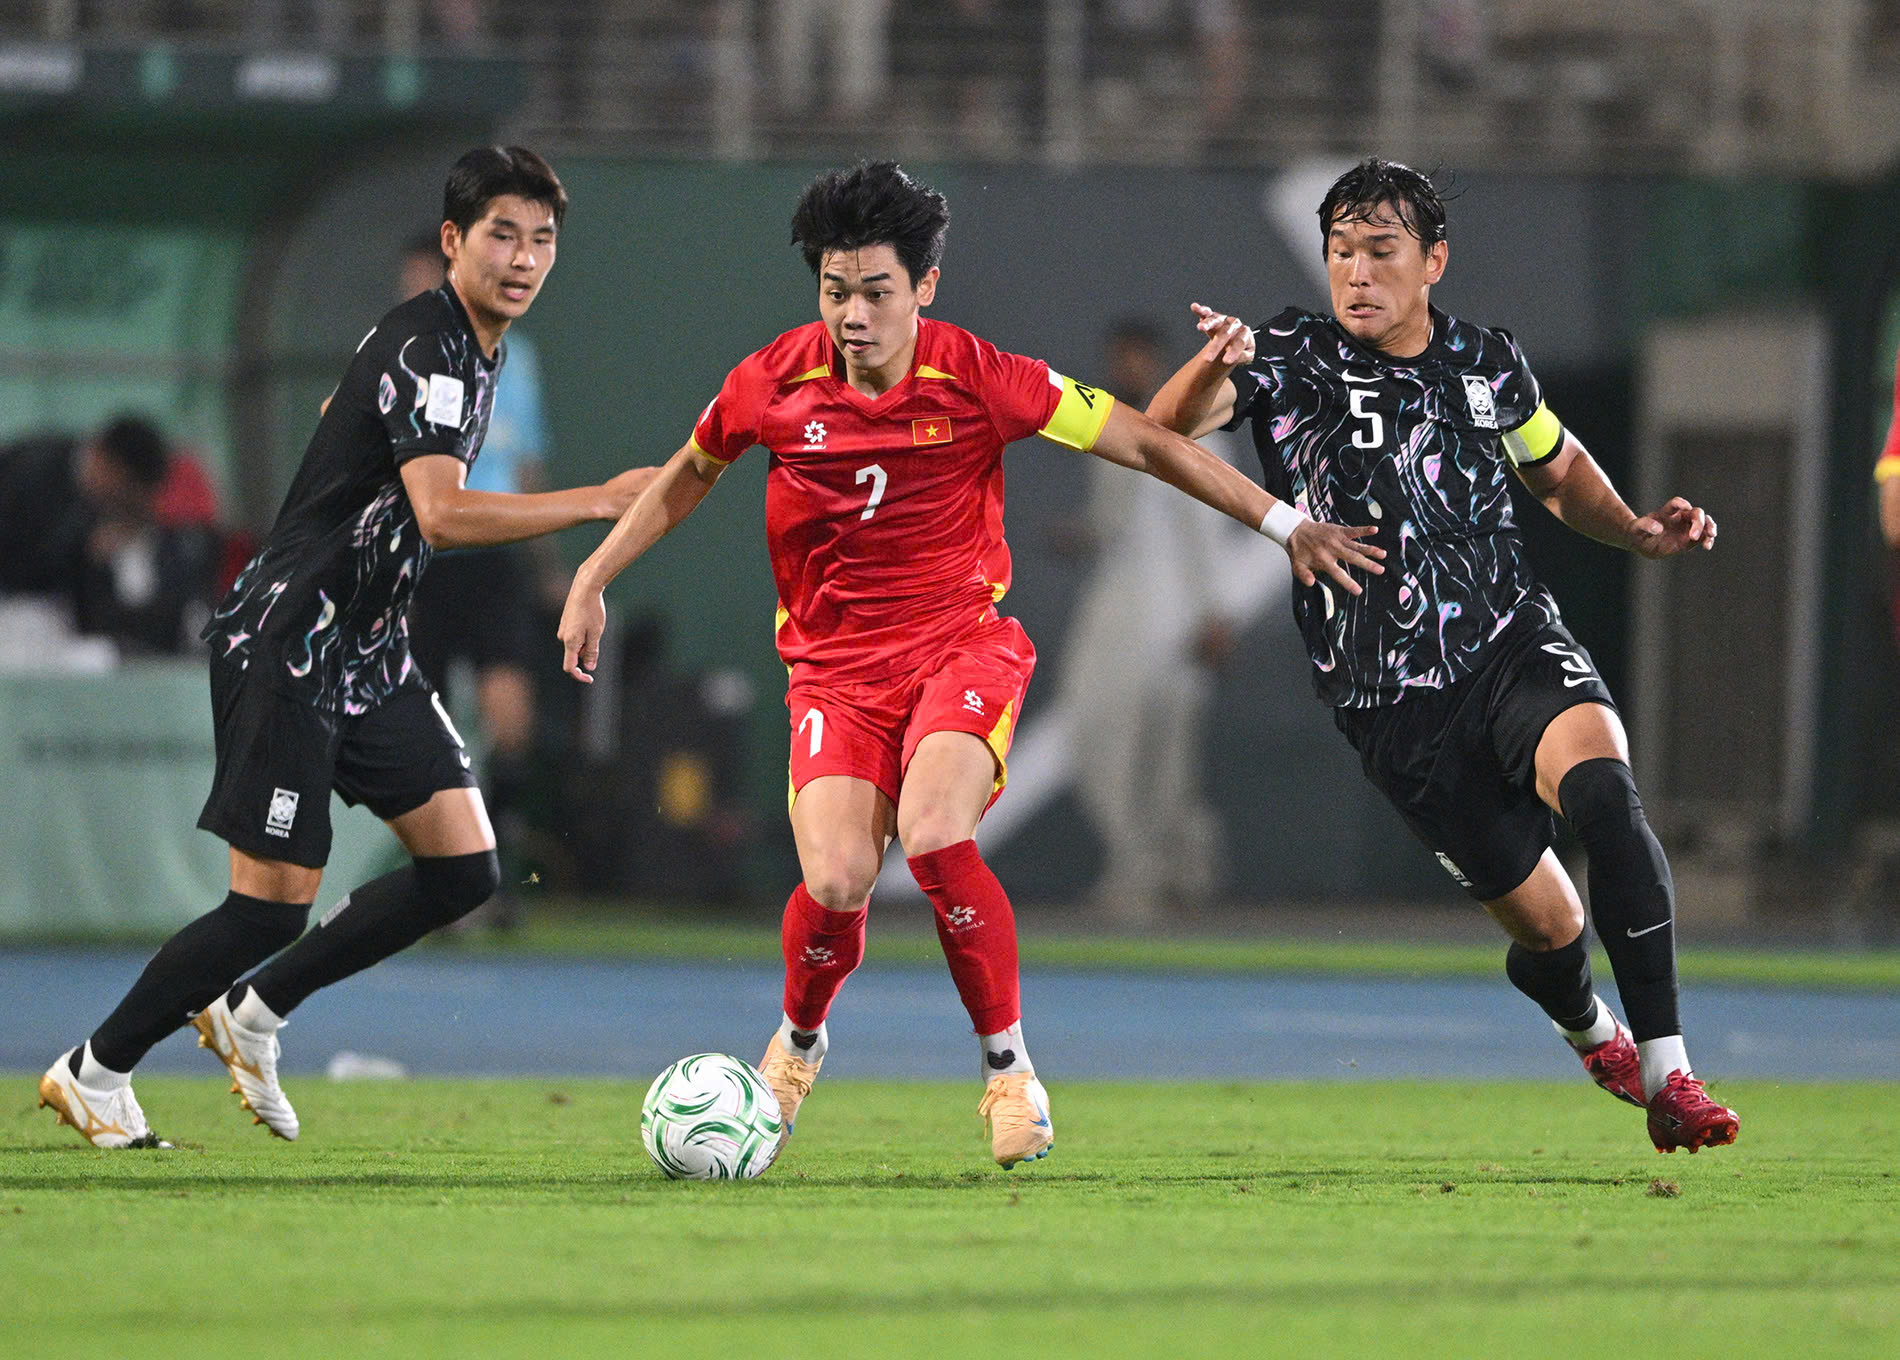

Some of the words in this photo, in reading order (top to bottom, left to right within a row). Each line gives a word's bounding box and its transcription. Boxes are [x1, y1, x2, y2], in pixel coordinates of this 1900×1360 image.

[1350, 389, 1384, 449] 5
[1474, 418, 1499, 430] KOREA
[855, 463, 888, 521] 7
[1540, 642, 1592, 673] 5
